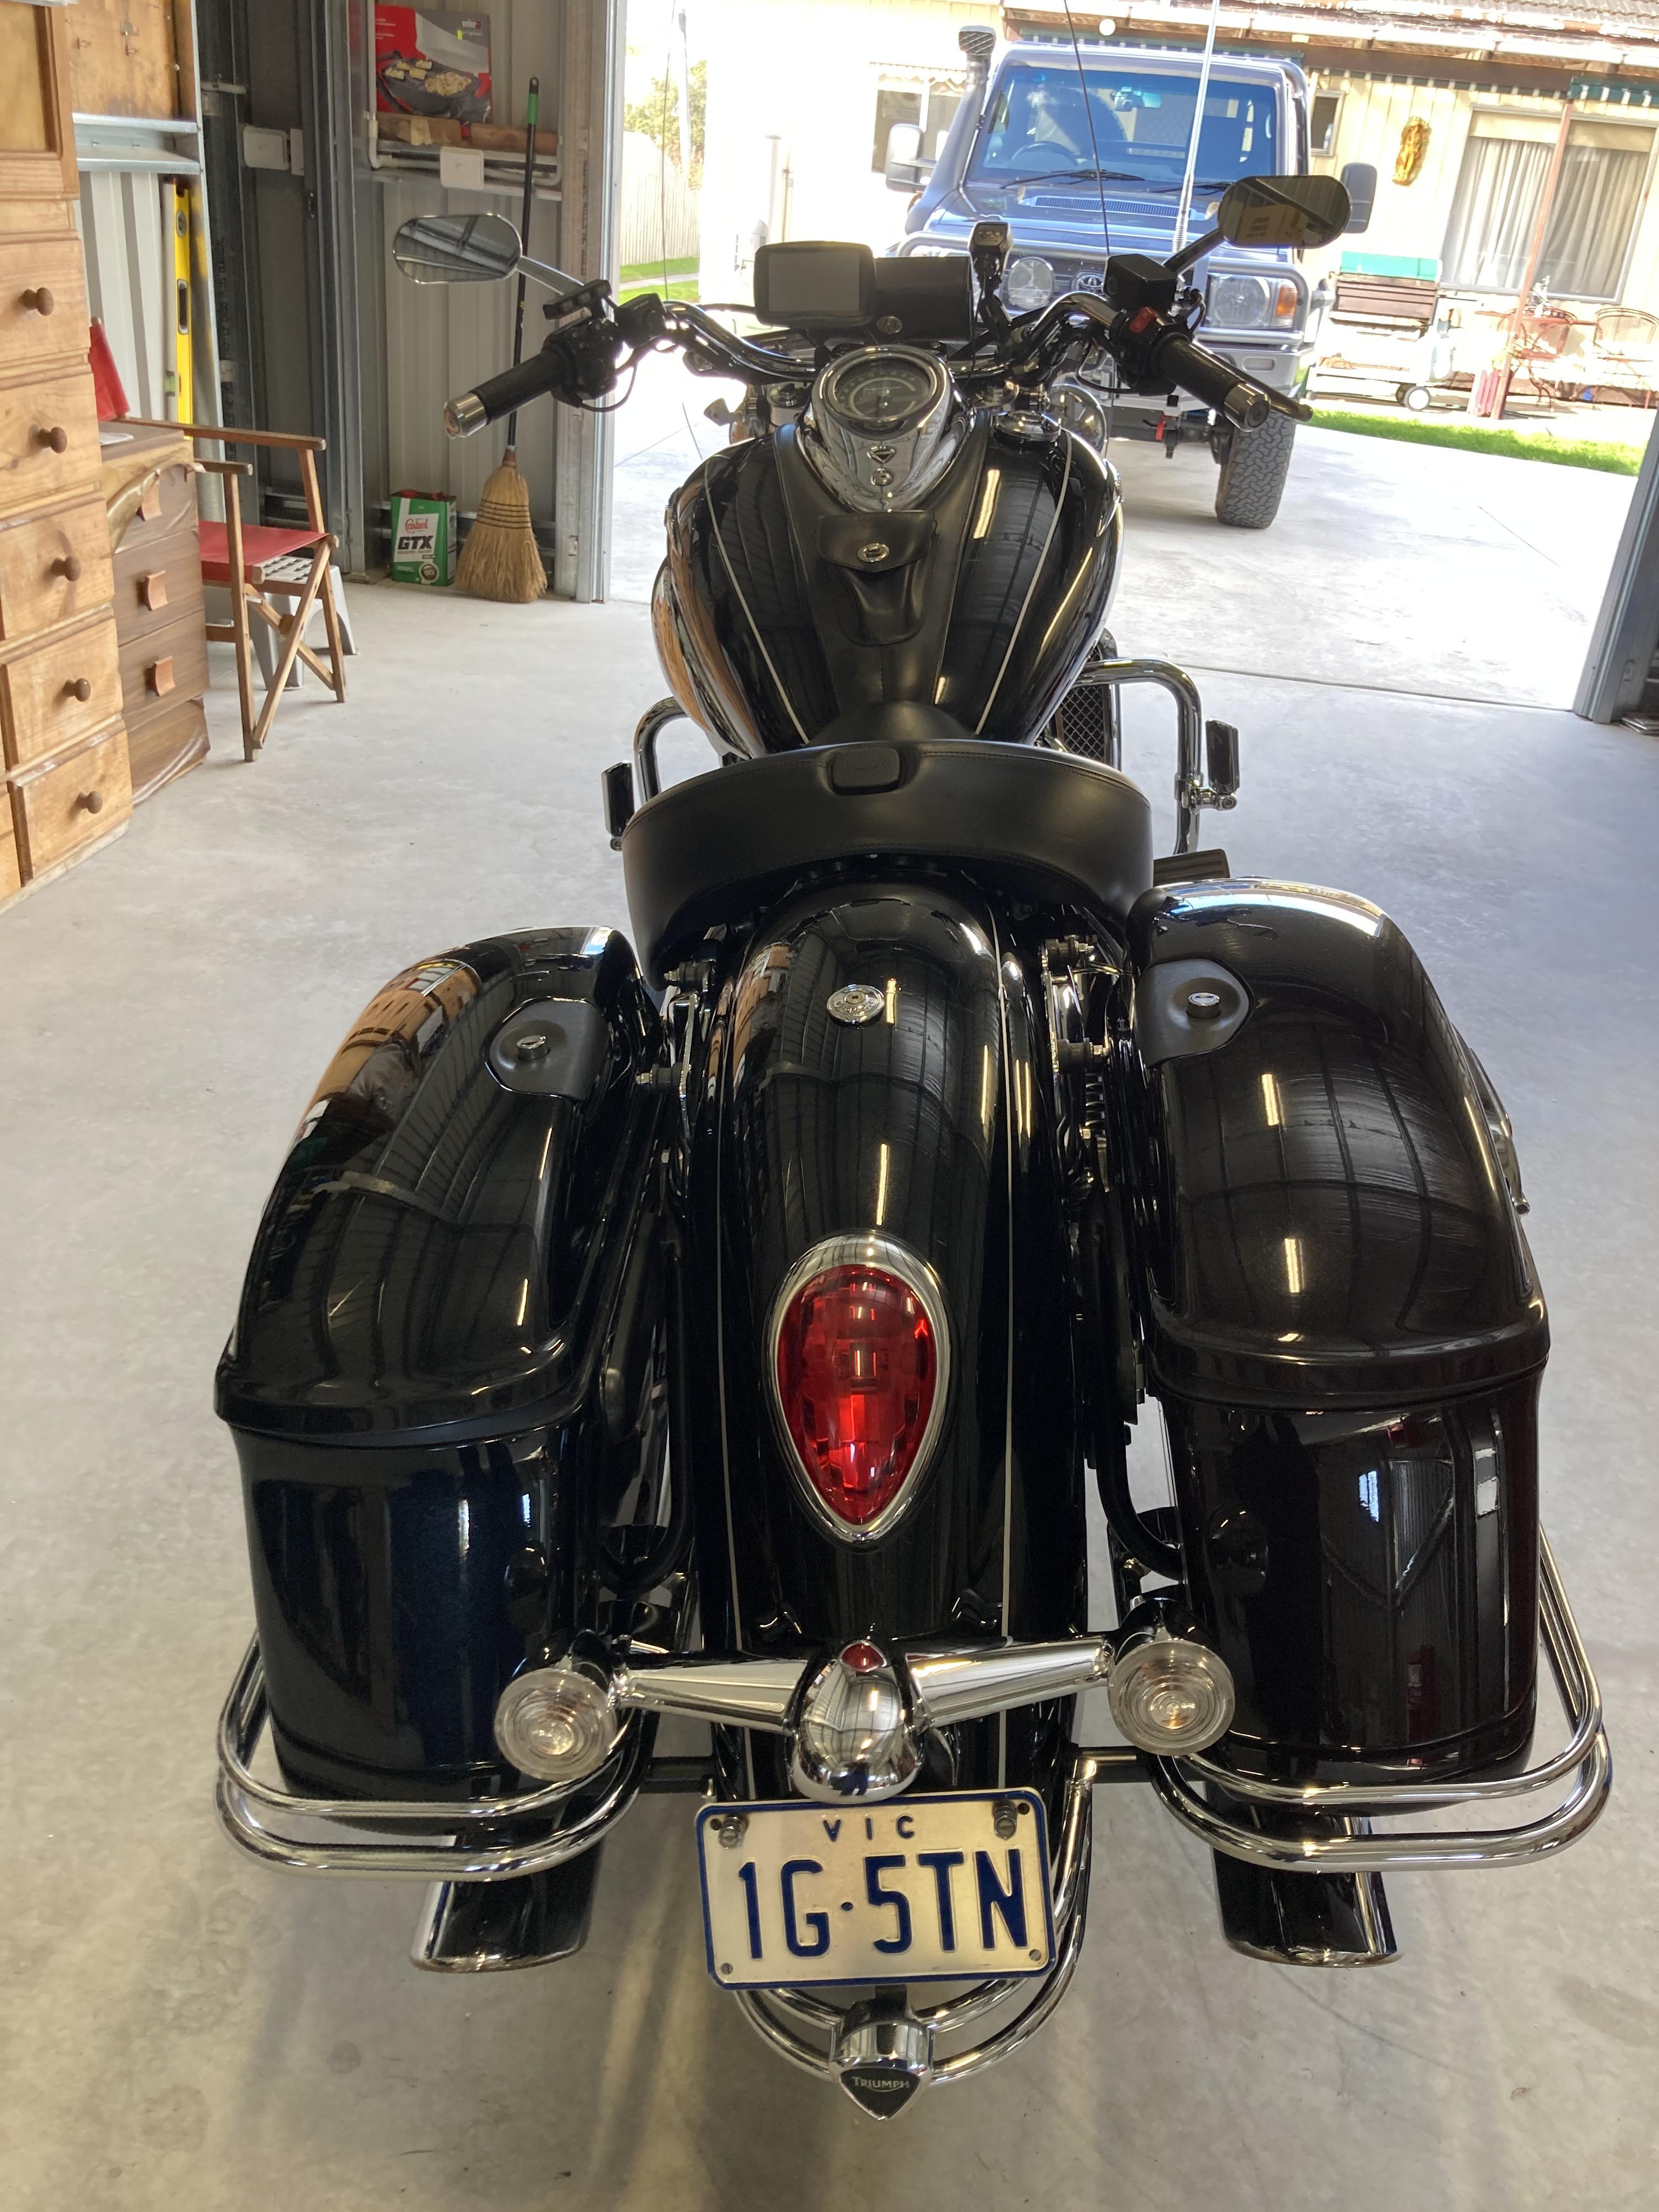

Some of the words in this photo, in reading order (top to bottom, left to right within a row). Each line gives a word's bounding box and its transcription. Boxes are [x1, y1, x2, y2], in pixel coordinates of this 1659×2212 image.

[405, 518, 428, 533] Castrol
[398, 535, 434, 550] GTX
[823, 1815, 915, 1843] VIC
[851, 2076, 909, 2090] TRIUMPH
